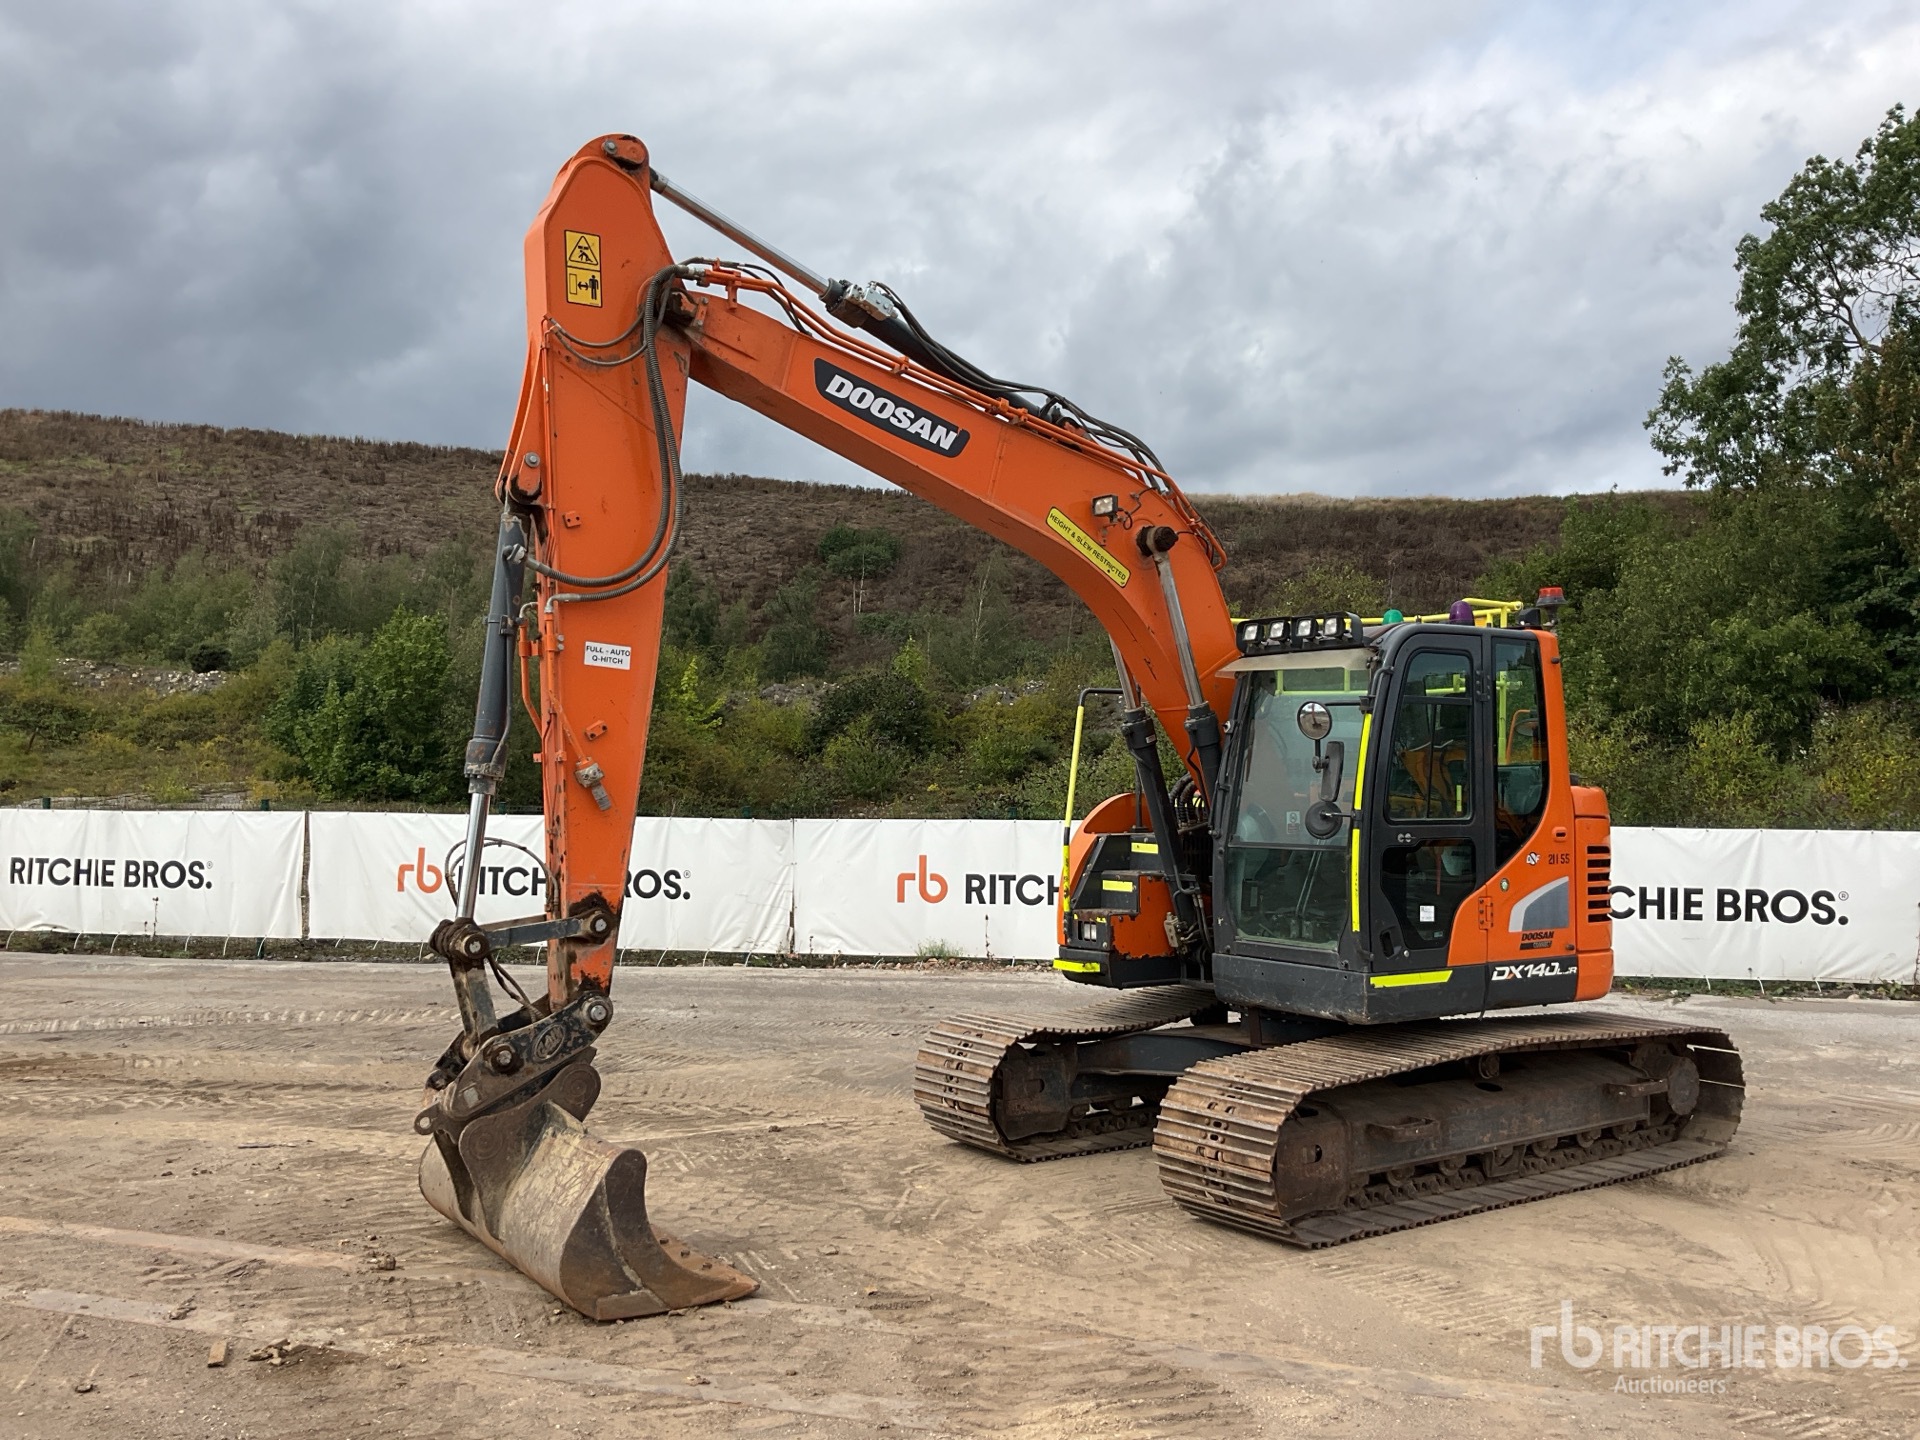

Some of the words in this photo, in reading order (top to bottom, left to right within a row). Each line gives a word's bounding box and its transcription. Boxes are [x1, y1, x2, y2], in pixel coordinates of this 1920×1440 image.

[825, 374, 957, 451] DOOSAN
[1050, 513, 1071, 534] HEIGHT
[1075, 535, 1092, 552] SLEW
[1092, 549, 1126, 581] RESTRICTED
[586, 645, 604, 654] FULL
[610, 649, 631, 657] AUTO
[592, 655, 623, 665] Q-HITCH
[10, 857, 116, 887] RITCHIE
[397, 847, 443, 893] rb
[897, 855, 948, 904] rb
[1522, 931, 1554, 941] DOOSAN
